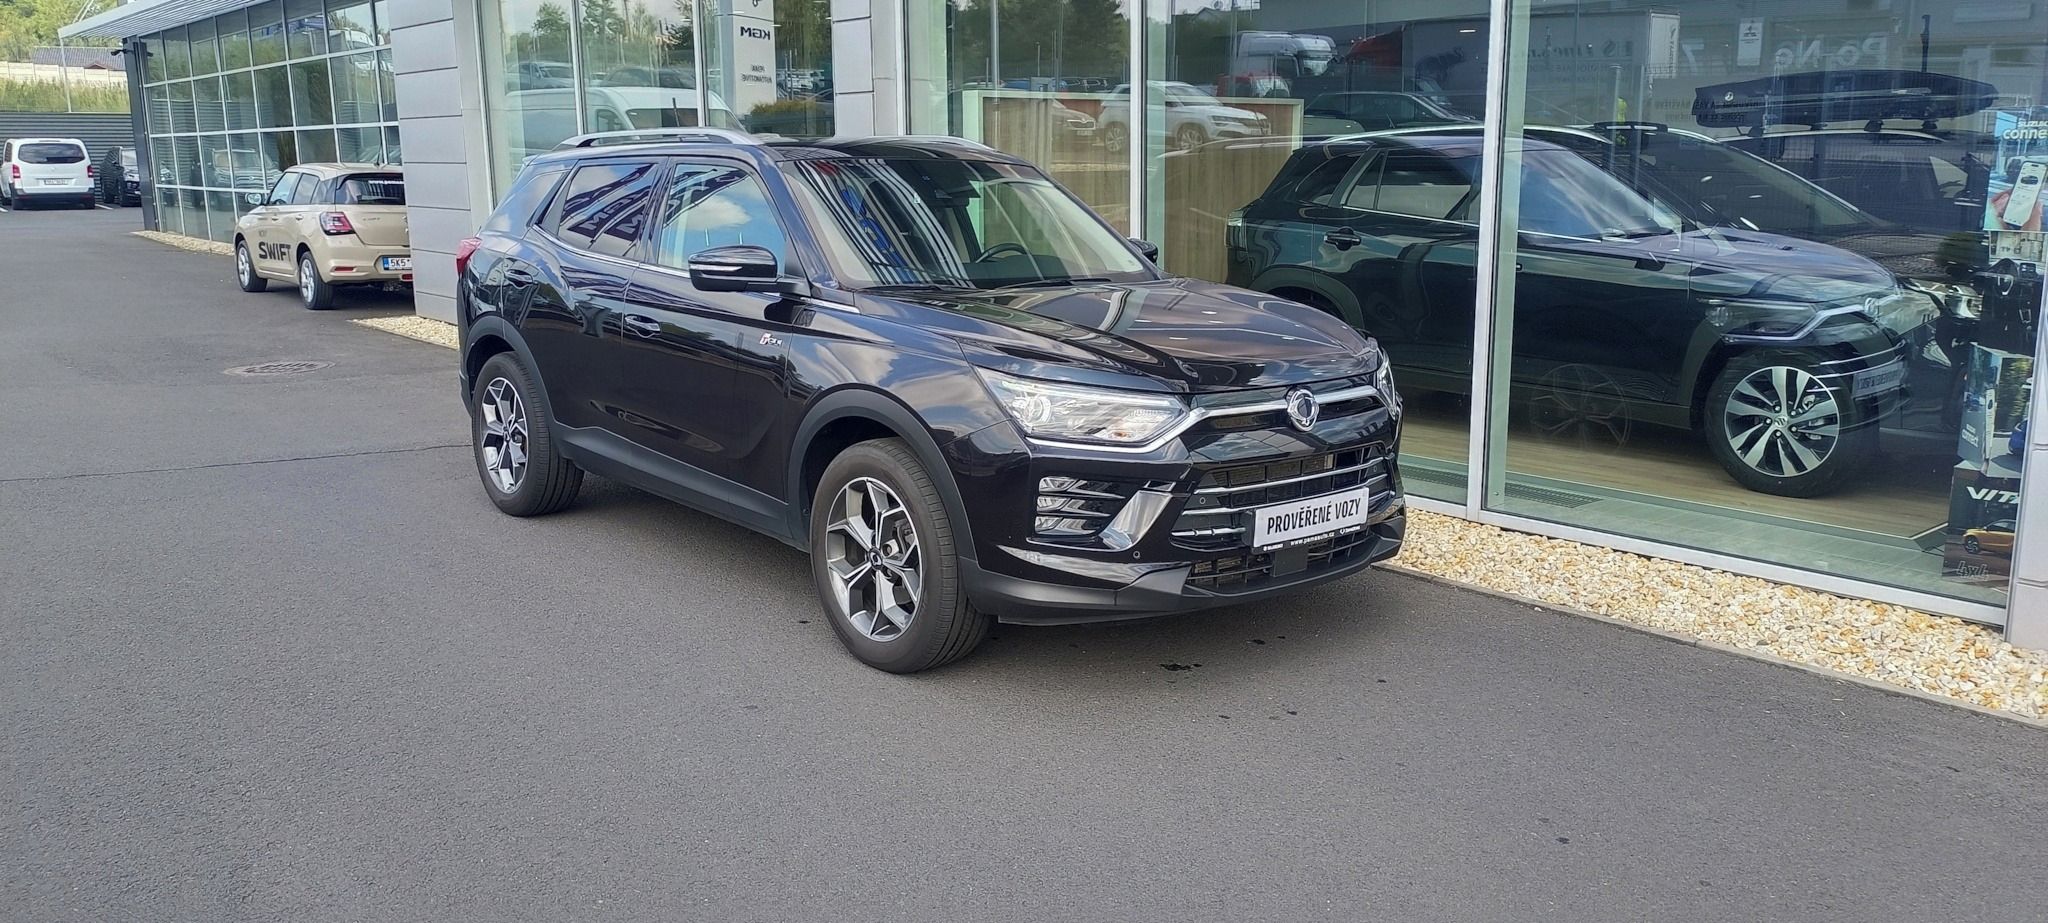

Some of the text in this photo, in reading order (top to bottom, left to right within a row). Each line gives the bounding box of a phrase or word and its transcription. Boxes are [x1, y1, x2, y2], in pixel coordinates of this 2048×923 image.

[258, 241, 292, 262] SWIFT
[1267, 498, 1361, 535] PROVĚŘENÉ VOZY
